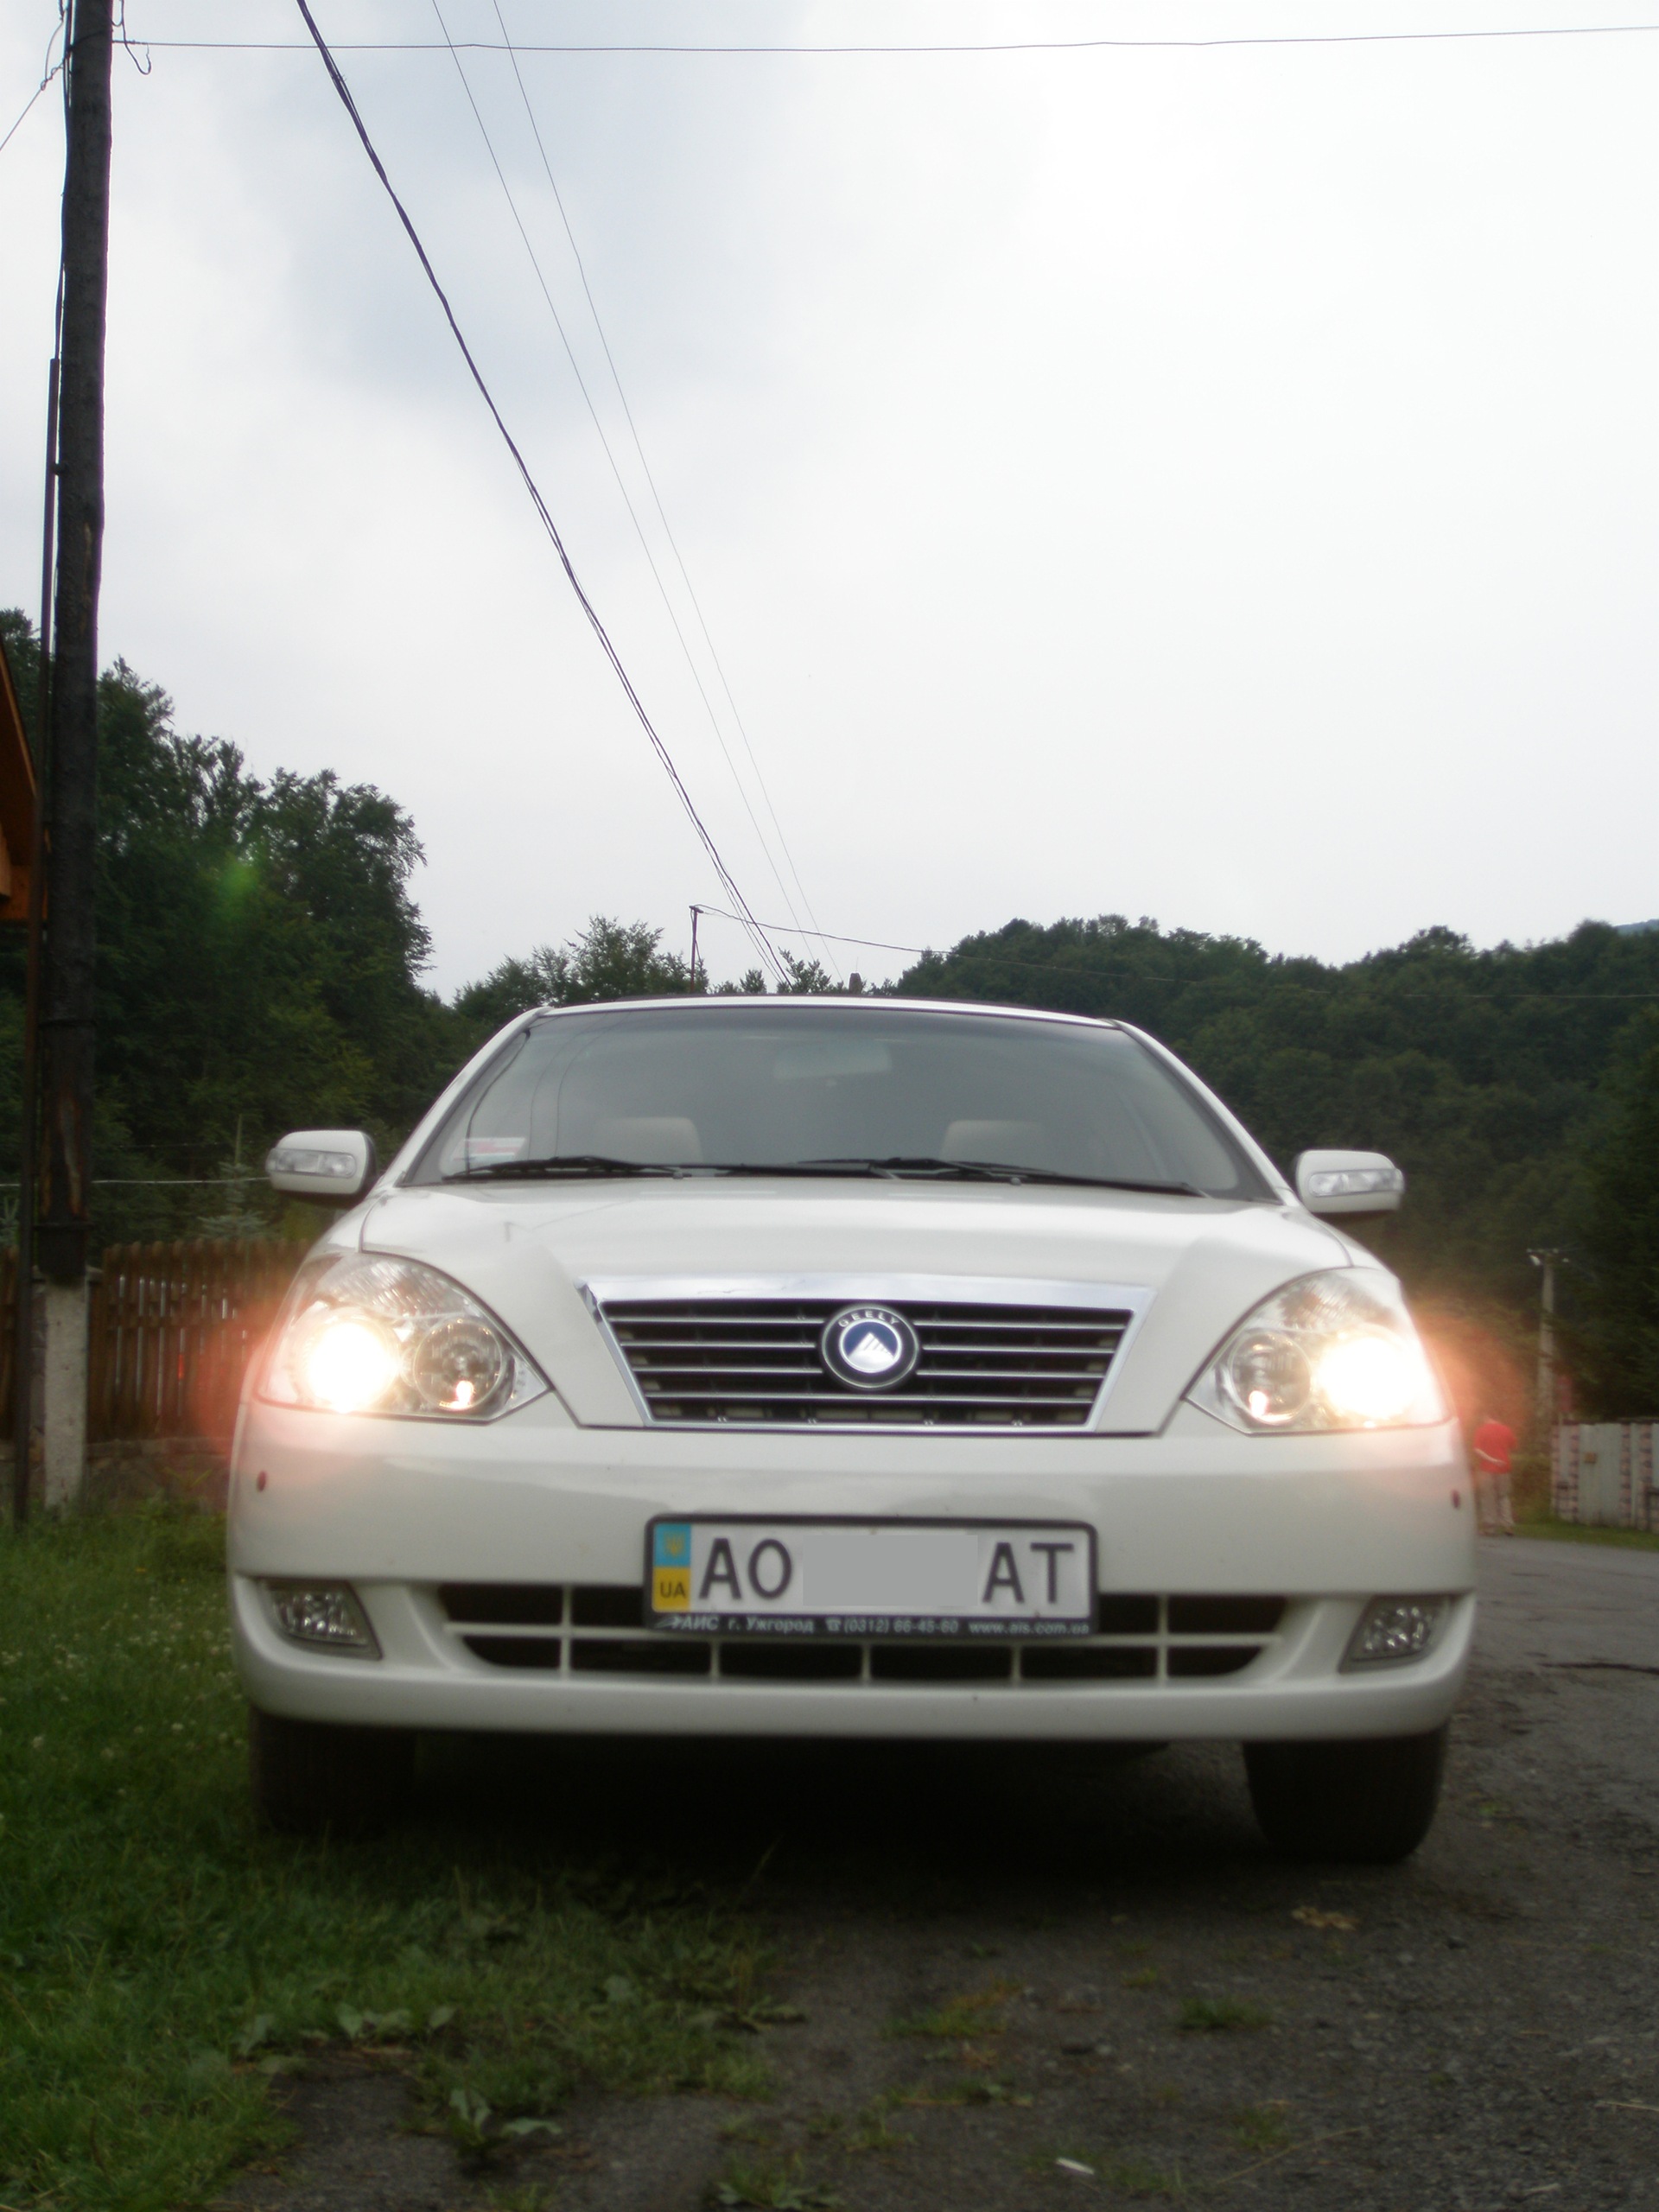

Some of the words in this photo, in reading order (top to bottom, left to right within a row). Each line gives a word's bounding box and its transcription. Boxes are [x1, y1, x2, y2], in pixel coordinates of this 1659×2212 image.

[838, 1310, 899, 1327] GEELY
[699, 1537, 793, 1600] AO
[982, 1542, 1075, 1605] AT
[659, 1582, 687, 1599] UA
[746, 1617, 816, 1634] Ужгород
[844, 1618, 889, 1633] (0312)
[968, 1621, 1090, 1636] www.ais.com.ua
